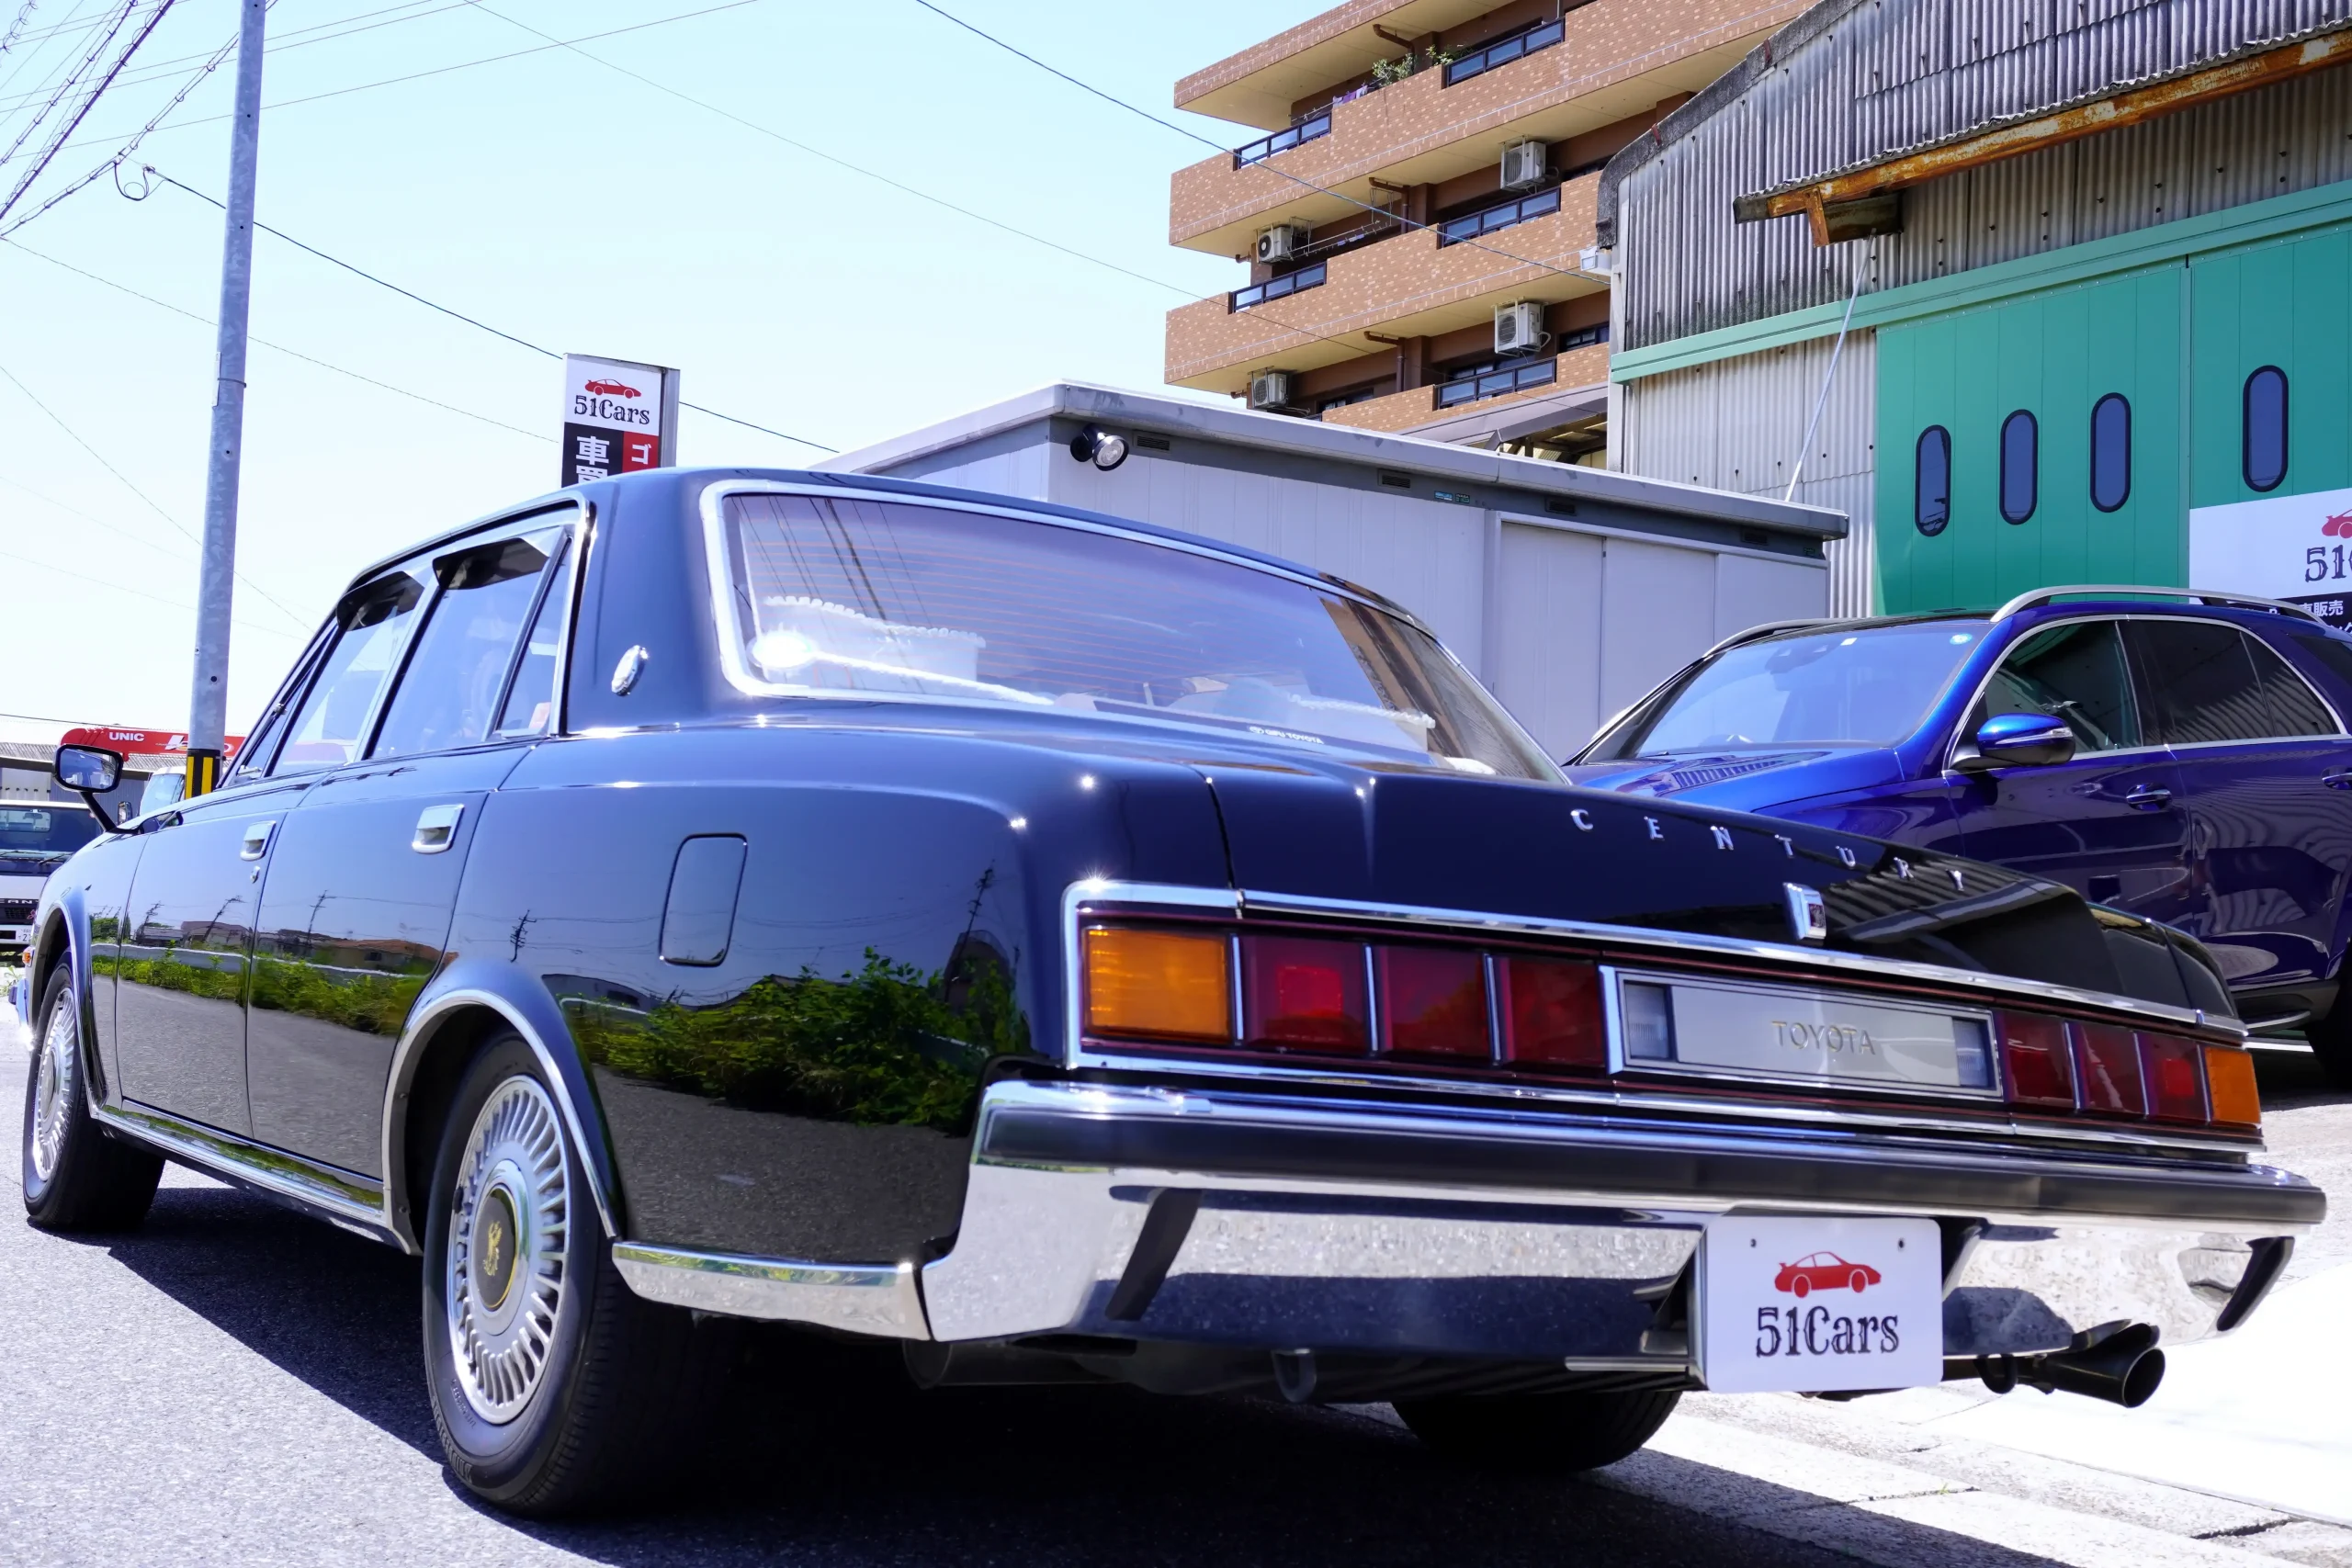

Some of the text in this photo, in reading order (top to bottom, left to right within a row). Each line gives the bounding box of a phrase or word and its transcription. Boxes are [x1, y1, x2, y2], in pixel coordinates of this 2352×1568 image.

[574, 395, 650, 425] 51Cars
[2304, 544, 2352, 583] 51
[108, 731, 145, 742] UNIC
[1570, 808, 1965, 892] CENTURY
[1771, 1021, 1876, 1055] TOYOTA
[1756, 1305, 1900, 1359] 51Cars
